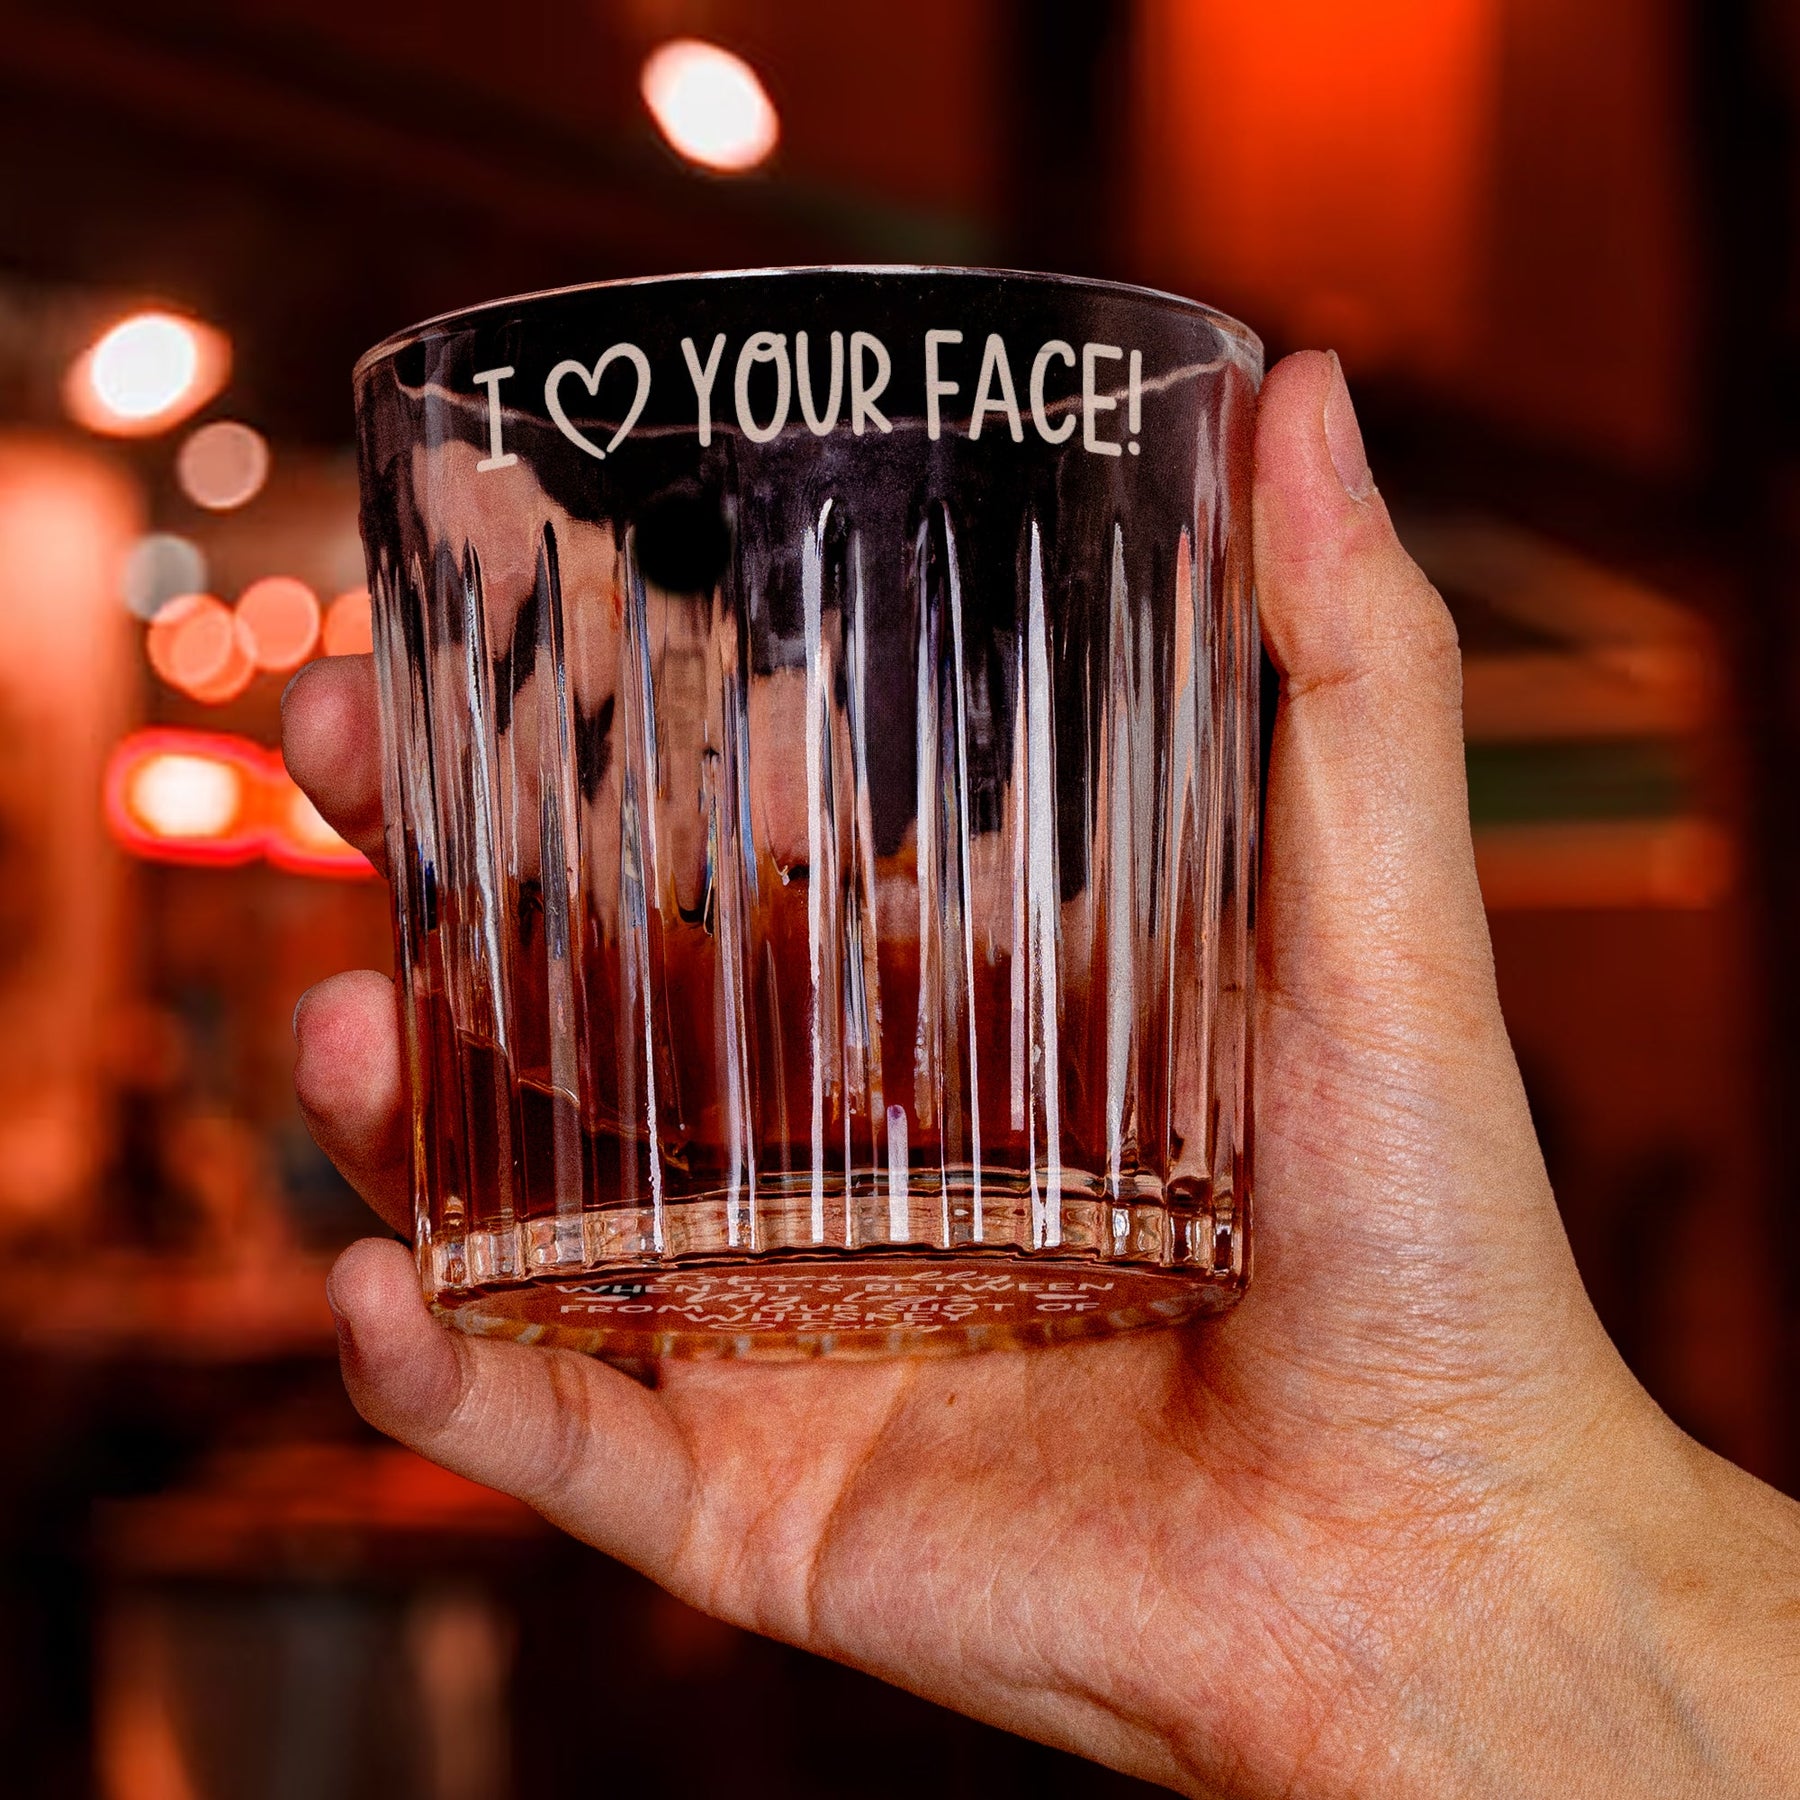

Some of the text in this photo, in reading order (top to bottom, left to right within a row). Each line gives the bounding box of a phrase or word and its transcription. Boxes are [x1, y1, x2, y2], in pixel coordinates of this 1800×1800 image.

[473, 329, 1143, 472] I YOUR FACE!
[555, 1282, 1115, 1294] WHEN IT'S BETWEEN
[560, 1302, 1101, 1314] FROM YOUR SHOT OF
[684, 1312, 974, 1322] WHISKEY
